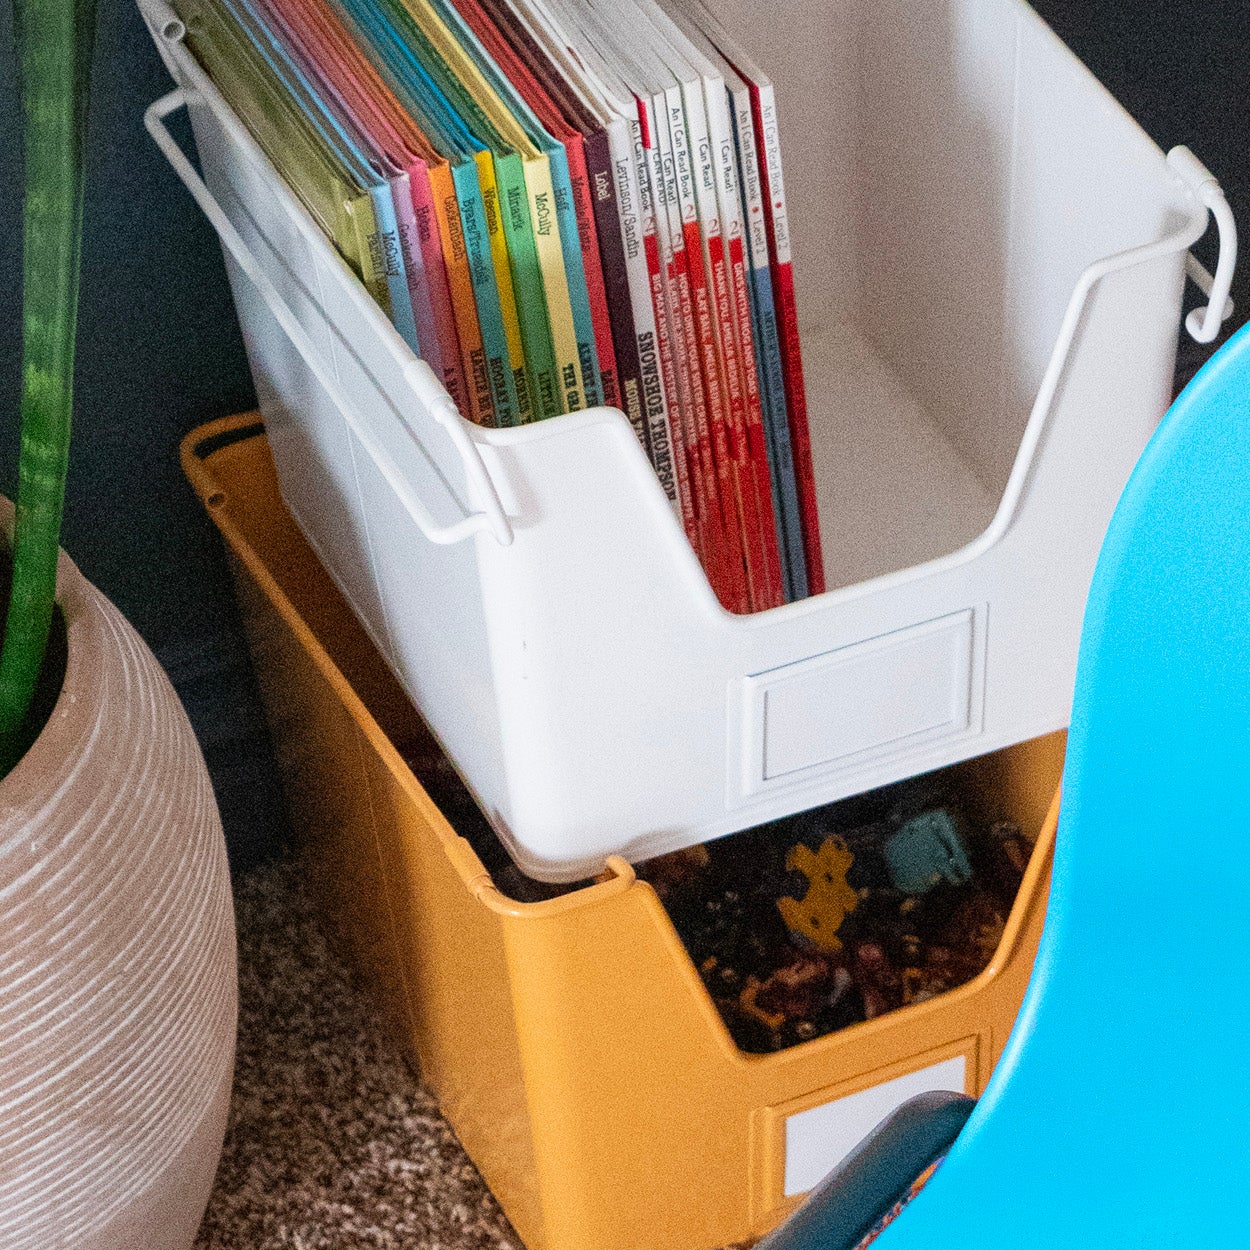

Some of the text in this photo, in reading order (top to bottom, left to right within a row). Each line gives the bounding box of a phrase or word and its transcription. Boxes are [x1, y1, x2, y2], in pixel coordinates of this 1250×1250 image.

[671, 107, 680, 119] An
[739, 109, 749, 124] An
[763, 104, 772, 120] An
[630, 118, 639, 133] An
[674, 129, 684, 148] Can
[765, 126, 775, 146] Can
[633, 142, 643, 162] Can
[699, 143, 708, 162] Can
[741, 131, 752, 150] Can
[663, 157, 673, 176] Can
[676, 151, 687, 173] Read
[721, 145, 730, 164] Can
[744, 151, 755, 174] Read
[767, 147, 778, 170] Read
[593, 170, 611, 201] Lobel
[636, 164, 646, 185] Read
[679, 175, 690, 198] Book
[701, 164, 712, 190] Read!
[723, 166, 733, 193] Read!
[770, 172, 781, 196] Book
[639, 188, 650, 211] Book
[665, 178, 676, 205] Read!
[747, 176, 758, 200] Book
[482, 186, 501, 236] Wiseman
[506, 185, 525, 232] Minarik
[531, 192, 553, 237] McCully
[614, 157, 641, 259] Levinson/Sandin
[683, 203, 695, 218] 2
[415, 204, 434, 243] Hoban
[443, 194, 466, 262] Gackenbach
[707, 218, 719, 233] 2
[728, 220, 740, 234] 2
[752, 219, 764, 245] Level
[775, 215, 786, 241] Level
[379, 229, 401, 277] McCully
[651, 273, 661, 290] BIG
[713, 259, 726, 296] THANK
[733, 262, 744, 287] DAYS
[653, 291, 665, 315] MAX
[695, 287, 707, 311] PLAY
[736, 289, 747, 315] WITH
[657, 316, 668, 340] AND
[721, 321, 733, 358] AMELIA
[739, 317, 750, 343] FROG
[660, 339, 671, 360] THE
[677, 272, 708, 436] HOW TO DRIVE YOUR SISTER CRAZY
[702, 343, 716, 379] AMELIA
[743, 344, 753, 367] AND
[470, 348, 489, 392] HATTIE
[489, 356, 509, 405] HOORAY
[561, 362, 576, 388] THE
[576, 341, 599, 408] ALBERT TH
[663, 360, 677, 403] MYSTERY
[726, 358, 739, 398] BEDELIA
[745, 367, 756, 394] TOAD
[512, 366, 529, 414] MORRIS
[537, 370, 556, 416] LITTLE
[623, 377, 642, 420] MOUSE
[707, 380, 722, 421] BEDELIA
[636, 331, 676, 501] SNOWSHOE THOMPSON
[669, 404, 679, 417] OF
[671, 421, 682, 439] THE
[674, 440, 688, 479] MISSING
[680, 480, 693, 519] GIRAFFE
